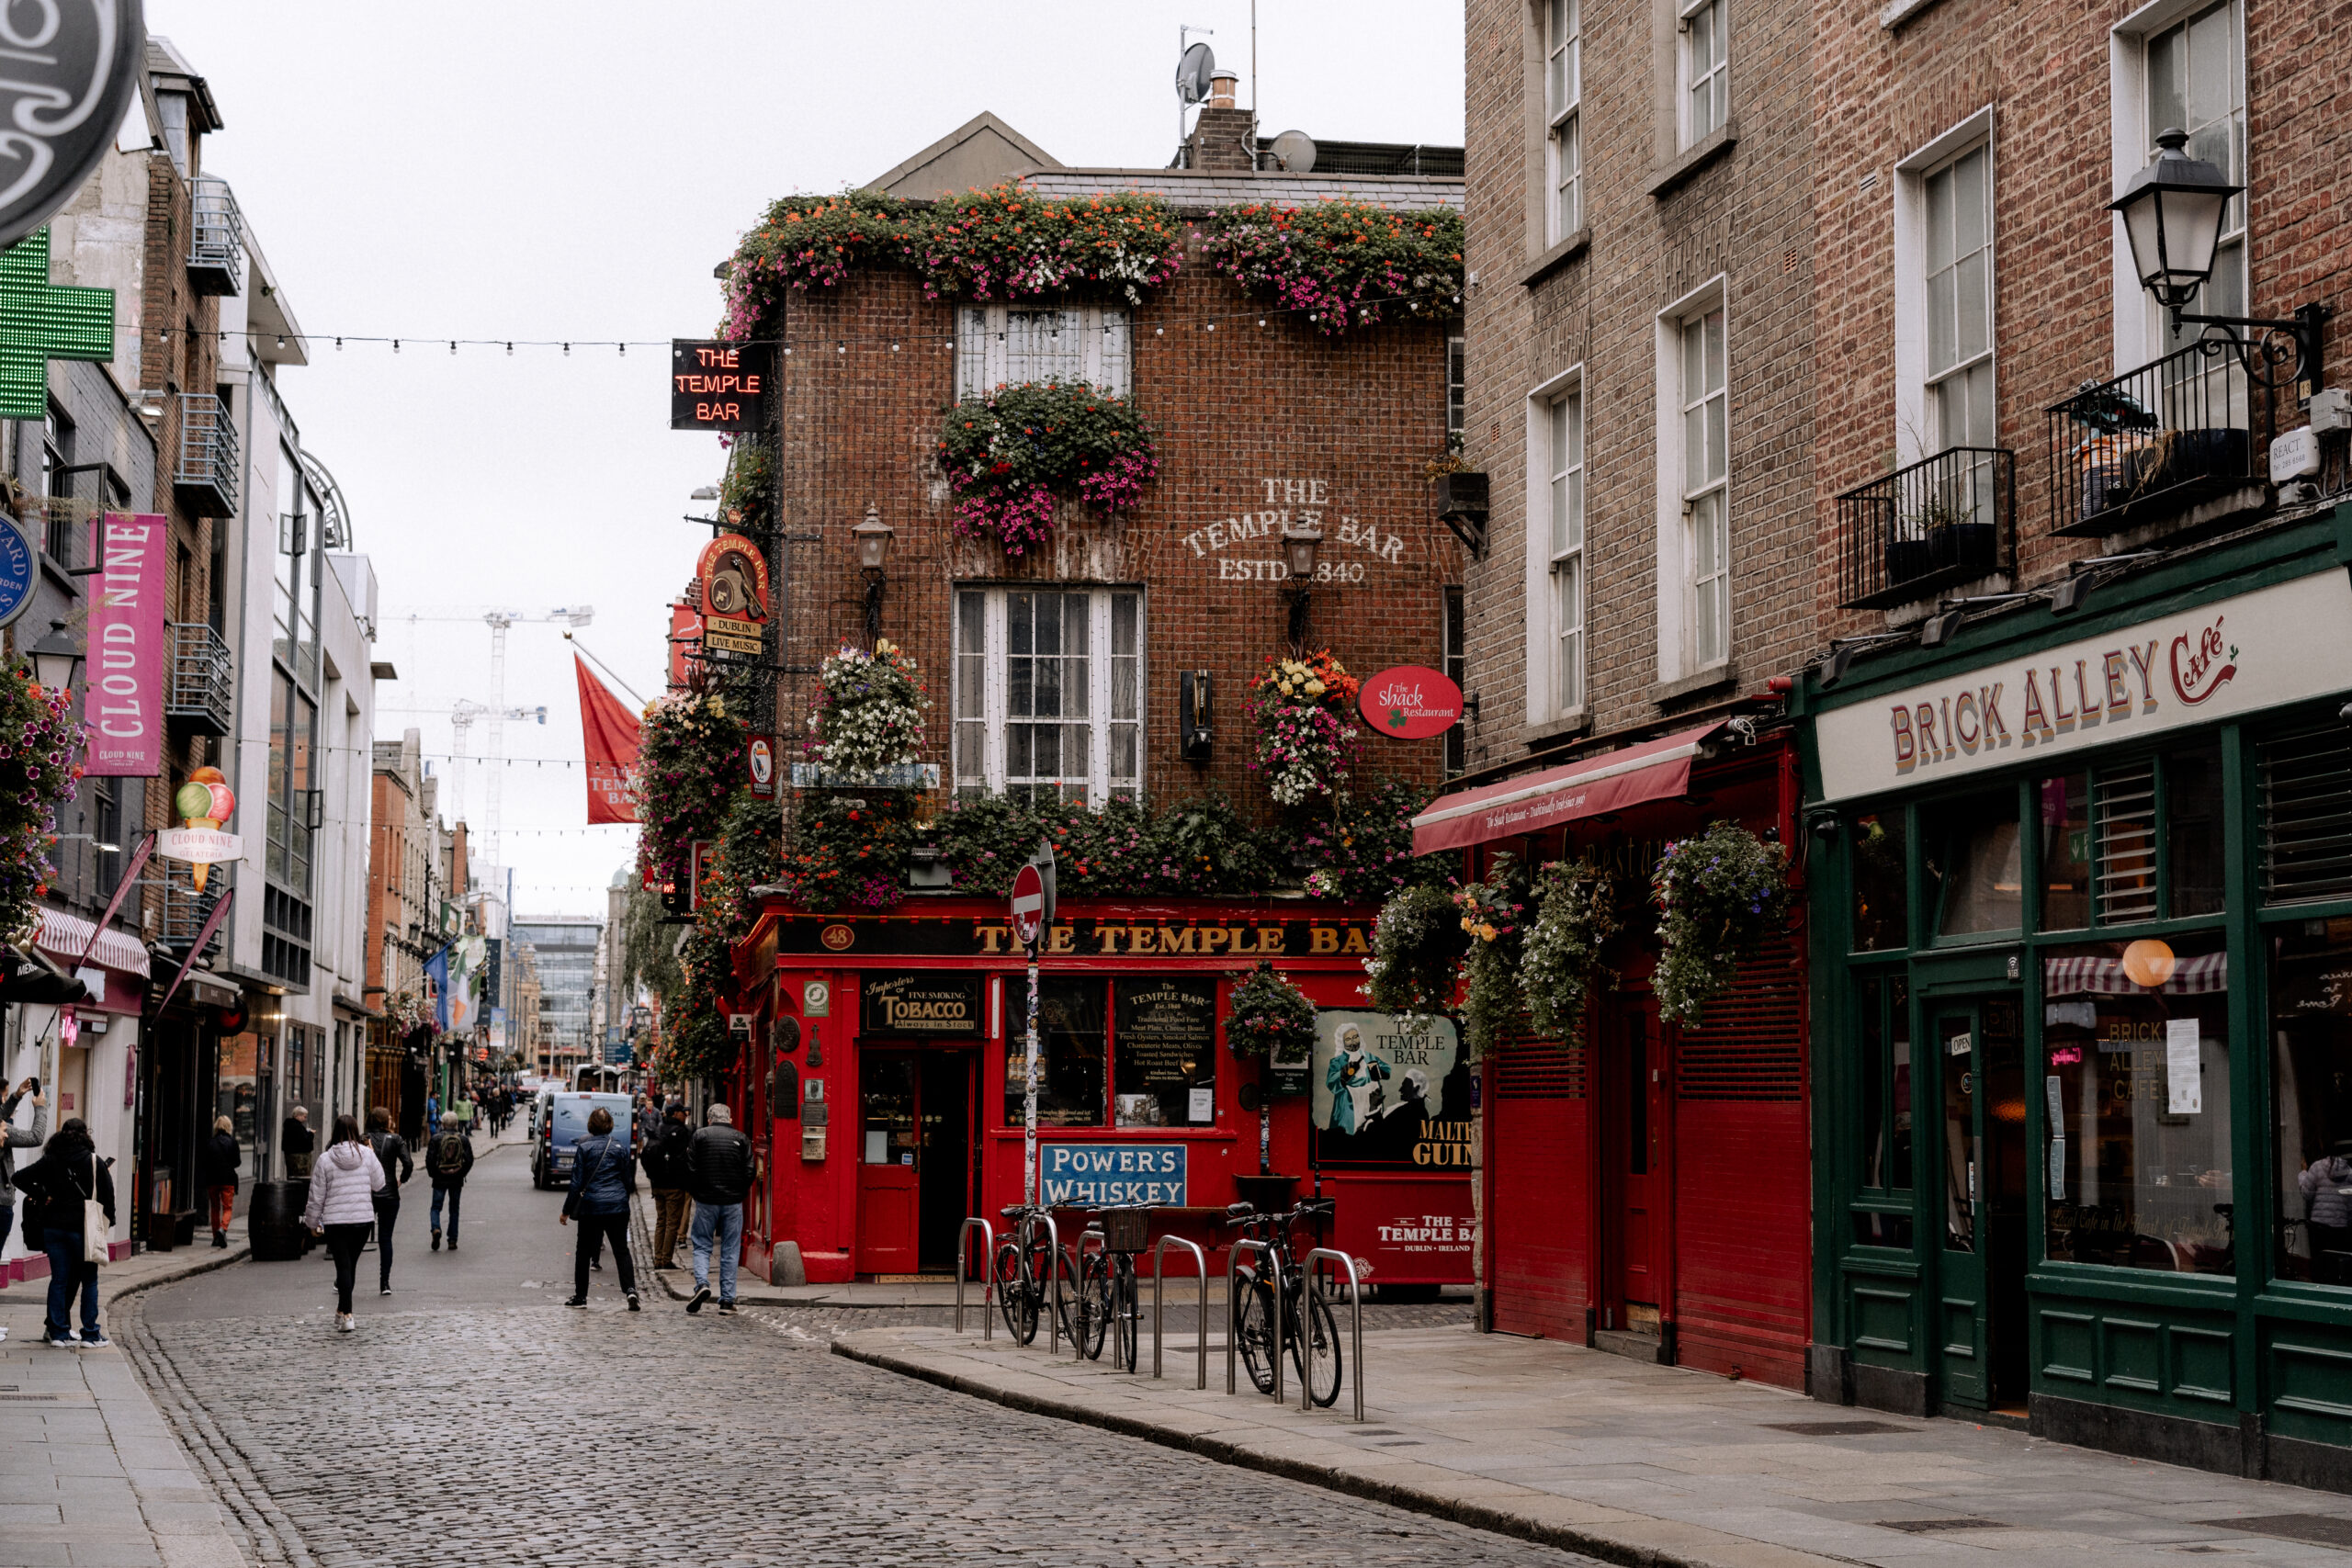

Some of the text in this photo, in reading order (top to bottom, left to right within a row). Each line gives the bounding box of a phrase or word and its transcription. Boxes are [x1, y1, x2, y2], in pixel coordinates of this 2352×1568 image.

[696, 349, 739, 367] THE
[674, 375, 760, 393] TEMPLE
[697, 402, 740, 421] BAR
[2273, 438, 2301, 460] REACT
[1261, 479, 1329, 504] THE
[1335, 515, 1404, 564] BAR
[705, 539, 766, 590] THE TEMPLE BAR
[1309, 561, 1364, 582] 840
[101, 525, 150, 738] CLOUD NINE
[718, 619, 752, 633] DUBLIN
[712, 636, 758, 652] LIVE MUSIC
[1379, 683, 1423, 708] Shack
[1395, 682, 1408, 693] The
[1403, 707, 1454, 717] Restaurant
[1890, 682, 2011, 773] BRICK
[2020, 639, 2158, 748] ALLEY
[99, 750, 145, 761] CLOUD NINE
[608, 792, 633, 805] BA
[172, 832, 233, 848] CLOUD NINE
[180, 850, 222, 859] GELATERIA
[827, 928, 847, 944] 48
[1095, 927, 1286, 953] TEMPLE
[1309, 927, 1370, 953] BA
[865, 976, 914, 995] Importers
[929, 992, 966, 1000] SMOKING
[1130, 991, 1204, 1006] TEMPLE BAR
[878, 996, 967, 1025] TOBACCO
[897, 1020, 929, 1028] Always
[947, 1020, 973, 1028] Stock
[2109, 1021, 2161, 1043] BRICK
[1375, 1035, 1445, 1050] TEMPLE
[1953, 1037, 1971, 1052] OPEN
[1394, 1050, 1430, 1065] BAR
[2109, 1050, 2163, 1072] ALLEY
[2114, 1079, 2159, 1100] CAFE
[1045, 1179, 1182, 1203] WHISKEY
[1422, 1215, 1453, 1227] THE
[1378, 1226, 1453, 1241] TEMPLE
